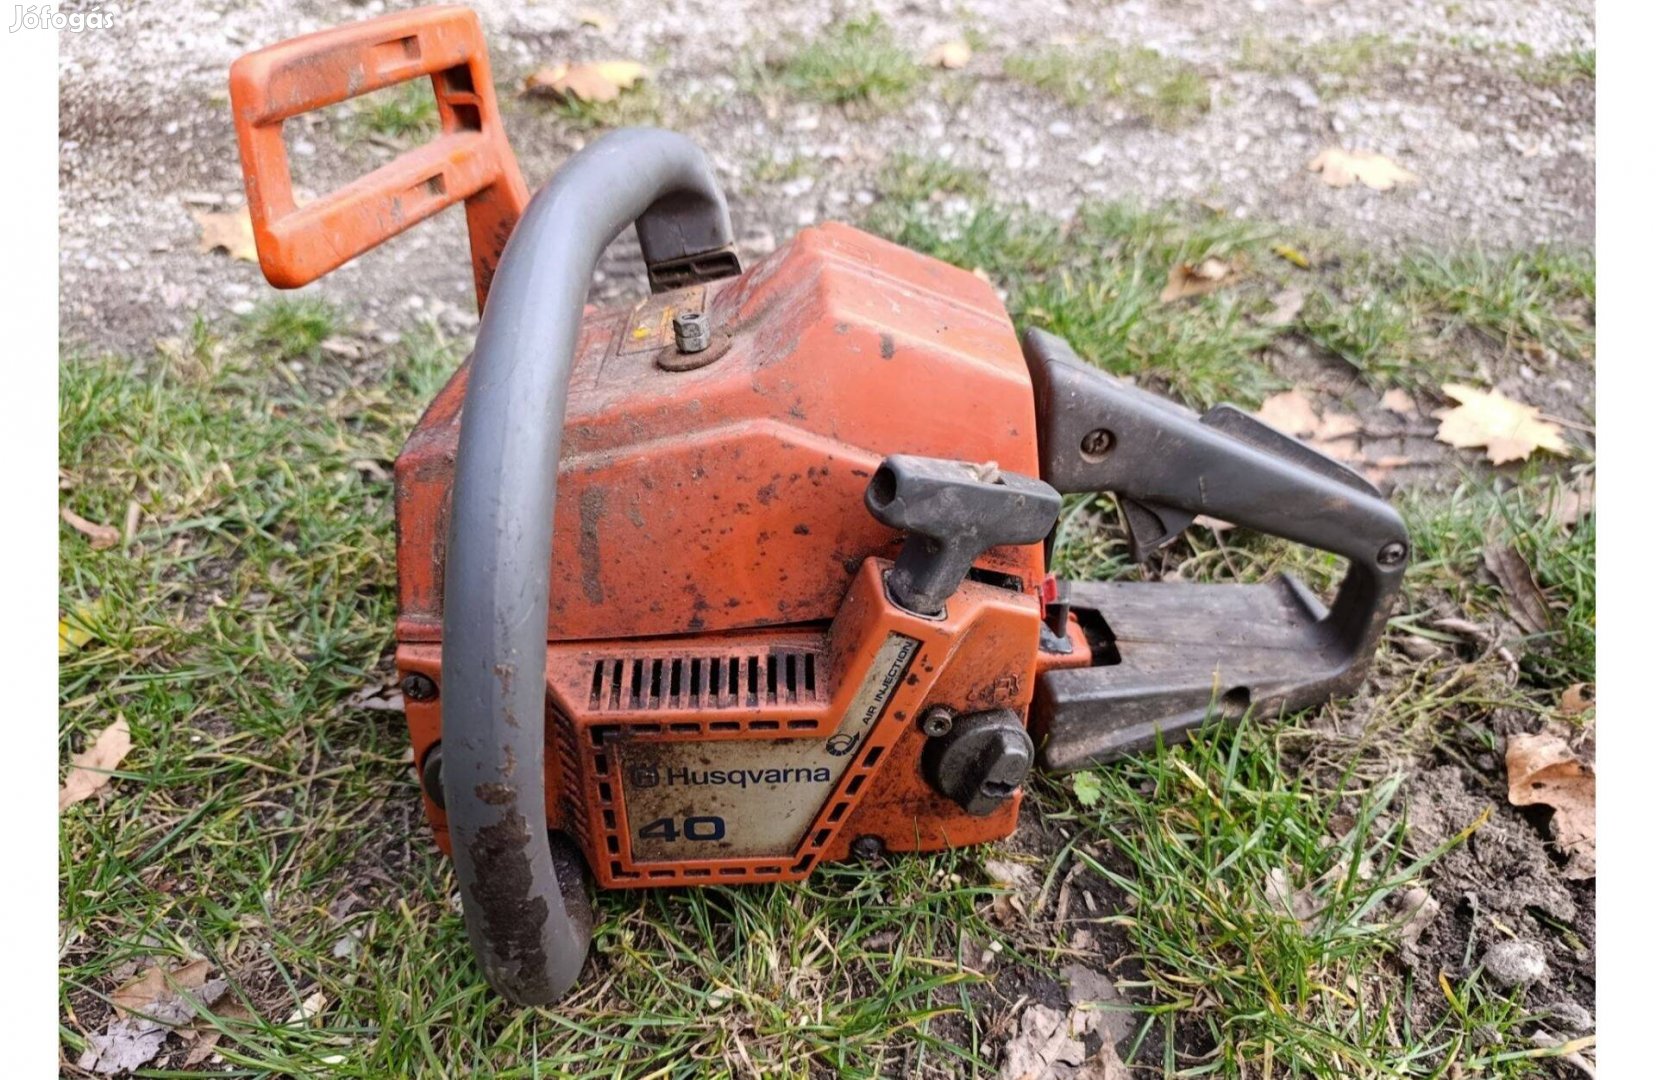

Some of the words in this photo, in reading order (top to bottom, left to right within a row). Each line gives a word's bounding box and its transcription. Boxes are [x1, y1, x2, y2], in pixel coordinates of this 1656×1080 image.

[862, 705, 877, 725] AIR
[874, 641, 914, 703] INJECTION
[667, 766, 831, 789] Husqvarna
[639, 816, 726, 842] 40
